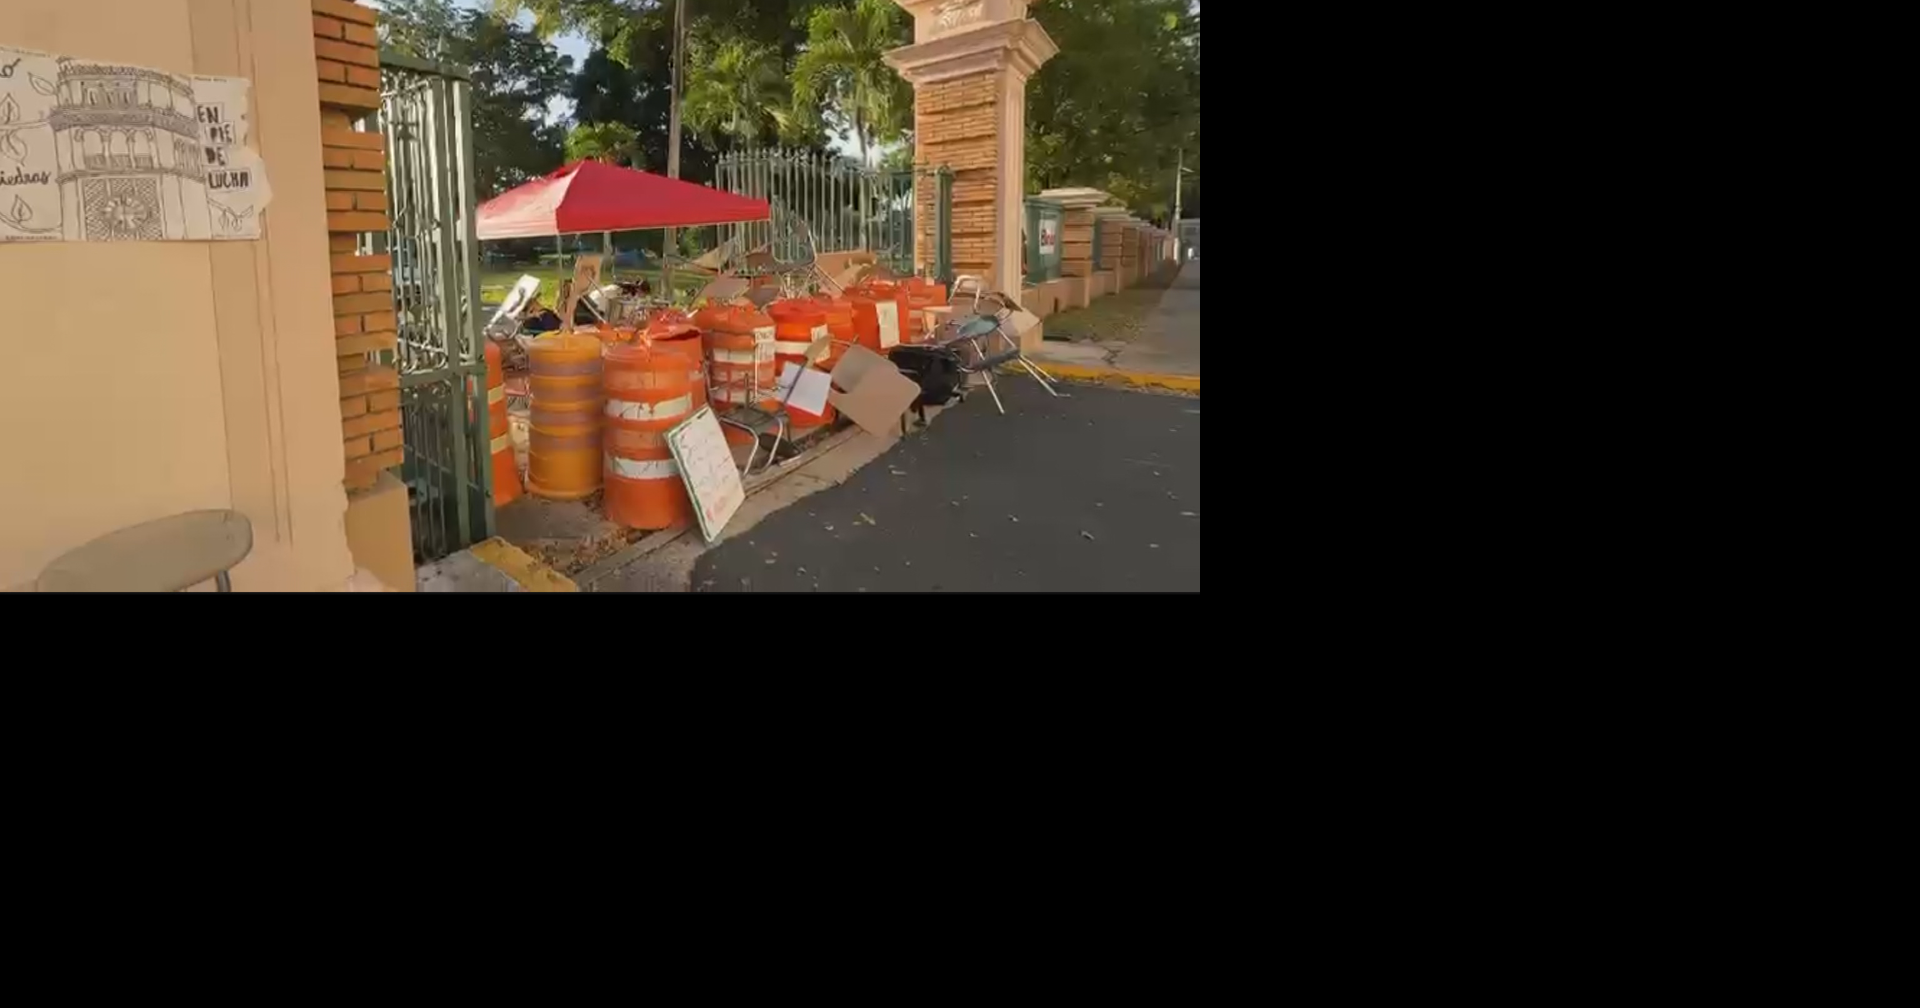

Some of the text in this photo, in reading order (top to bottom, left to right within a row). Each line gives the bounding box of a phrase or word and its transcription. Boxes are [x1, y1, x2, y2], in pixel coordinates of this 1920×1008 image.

[197, 105, 219, 124] EN
[209, 124, 233, 143] PIE
[205, 146, 226, 166] DE
[0, 166, 52, 186] iedras
[208, 171, 249, 189] LUCHA
